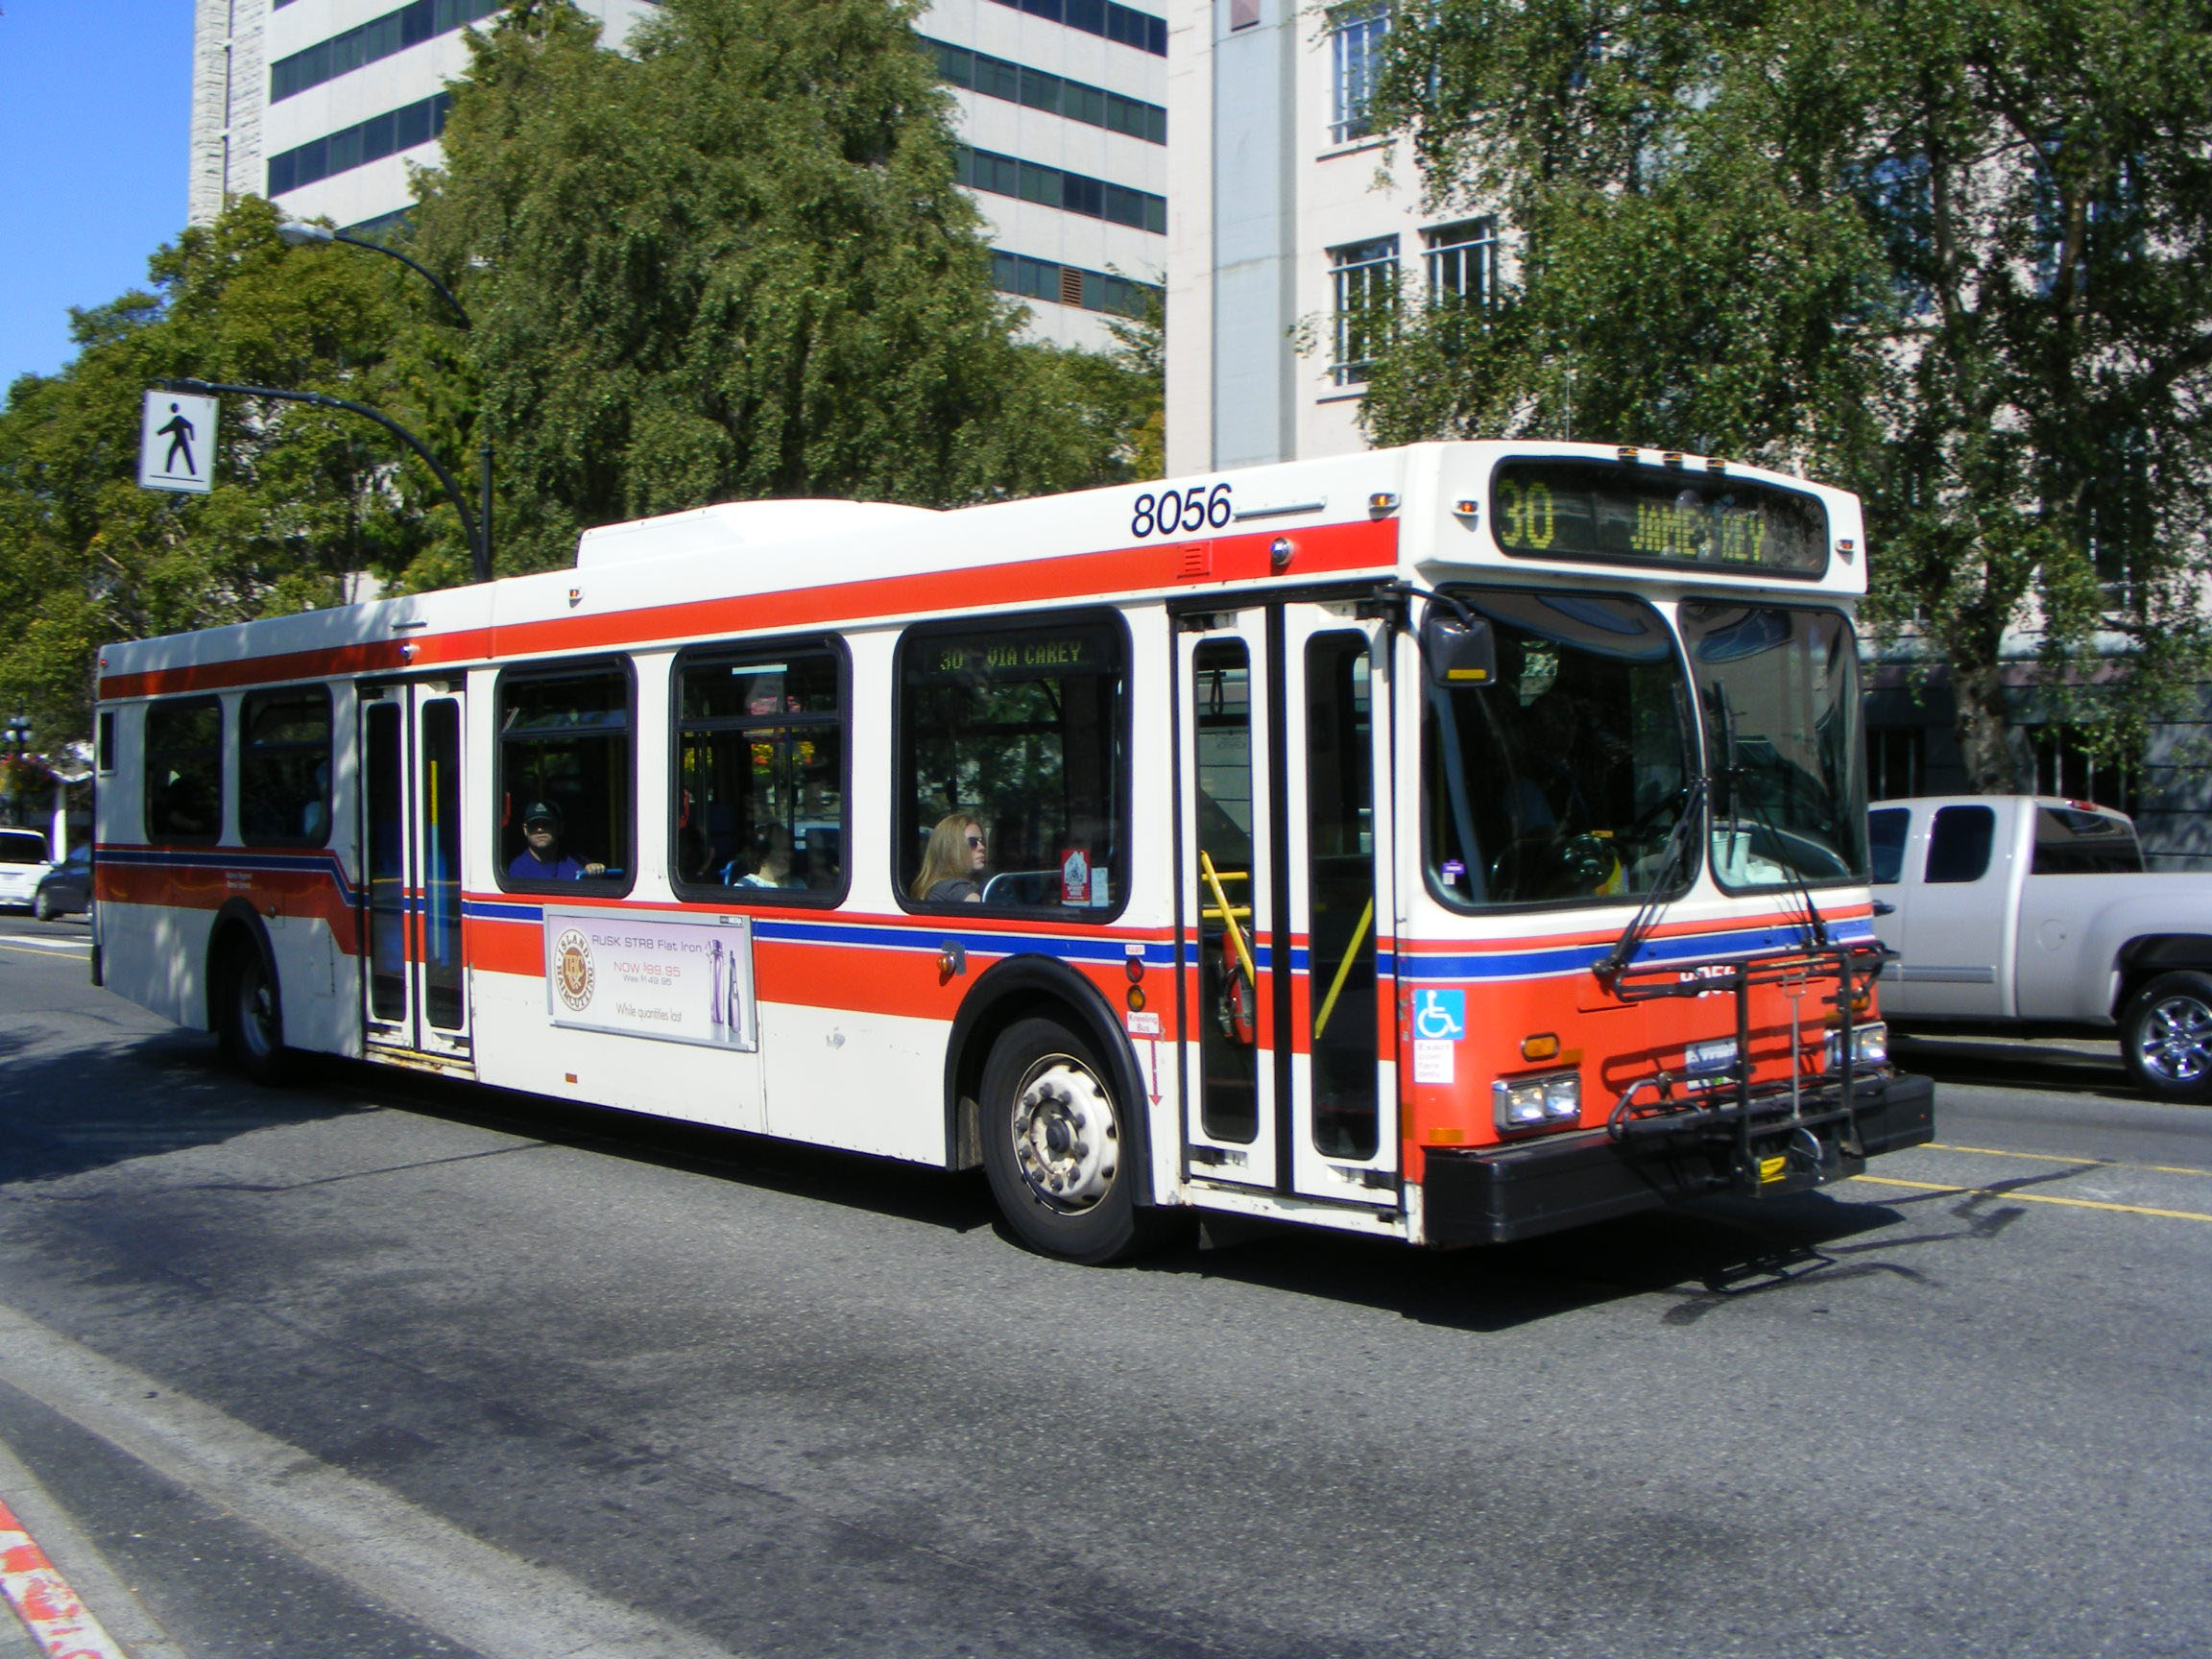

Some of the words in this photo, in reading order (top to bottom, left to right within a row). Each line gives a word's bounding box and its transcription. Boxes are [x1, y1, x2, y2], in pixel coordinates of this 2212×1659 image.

[1131, 482, 1233, 539] 8056
[1496, 480, 1554, 550] 30
[986, 645, 1018, 668] VIA
[1023, 640, 1082, 665] CAREY
[558, 934, 589, 958] ISLAND
[591, 934, 621, 948] RUSK
[658, 940, 678, 951] Flat
[682, 941, 703, 953] Iron
[613, 961, 640, 974] NOW
[557, 965, 594, 1008] HAIRCUTTING
[615, 1002, 637, 1018] While
[637, 1006, 669, 1022] quantities
[670, 1009, 683, 1022] last
[1137, 1022, 1150, 1032] Bus
